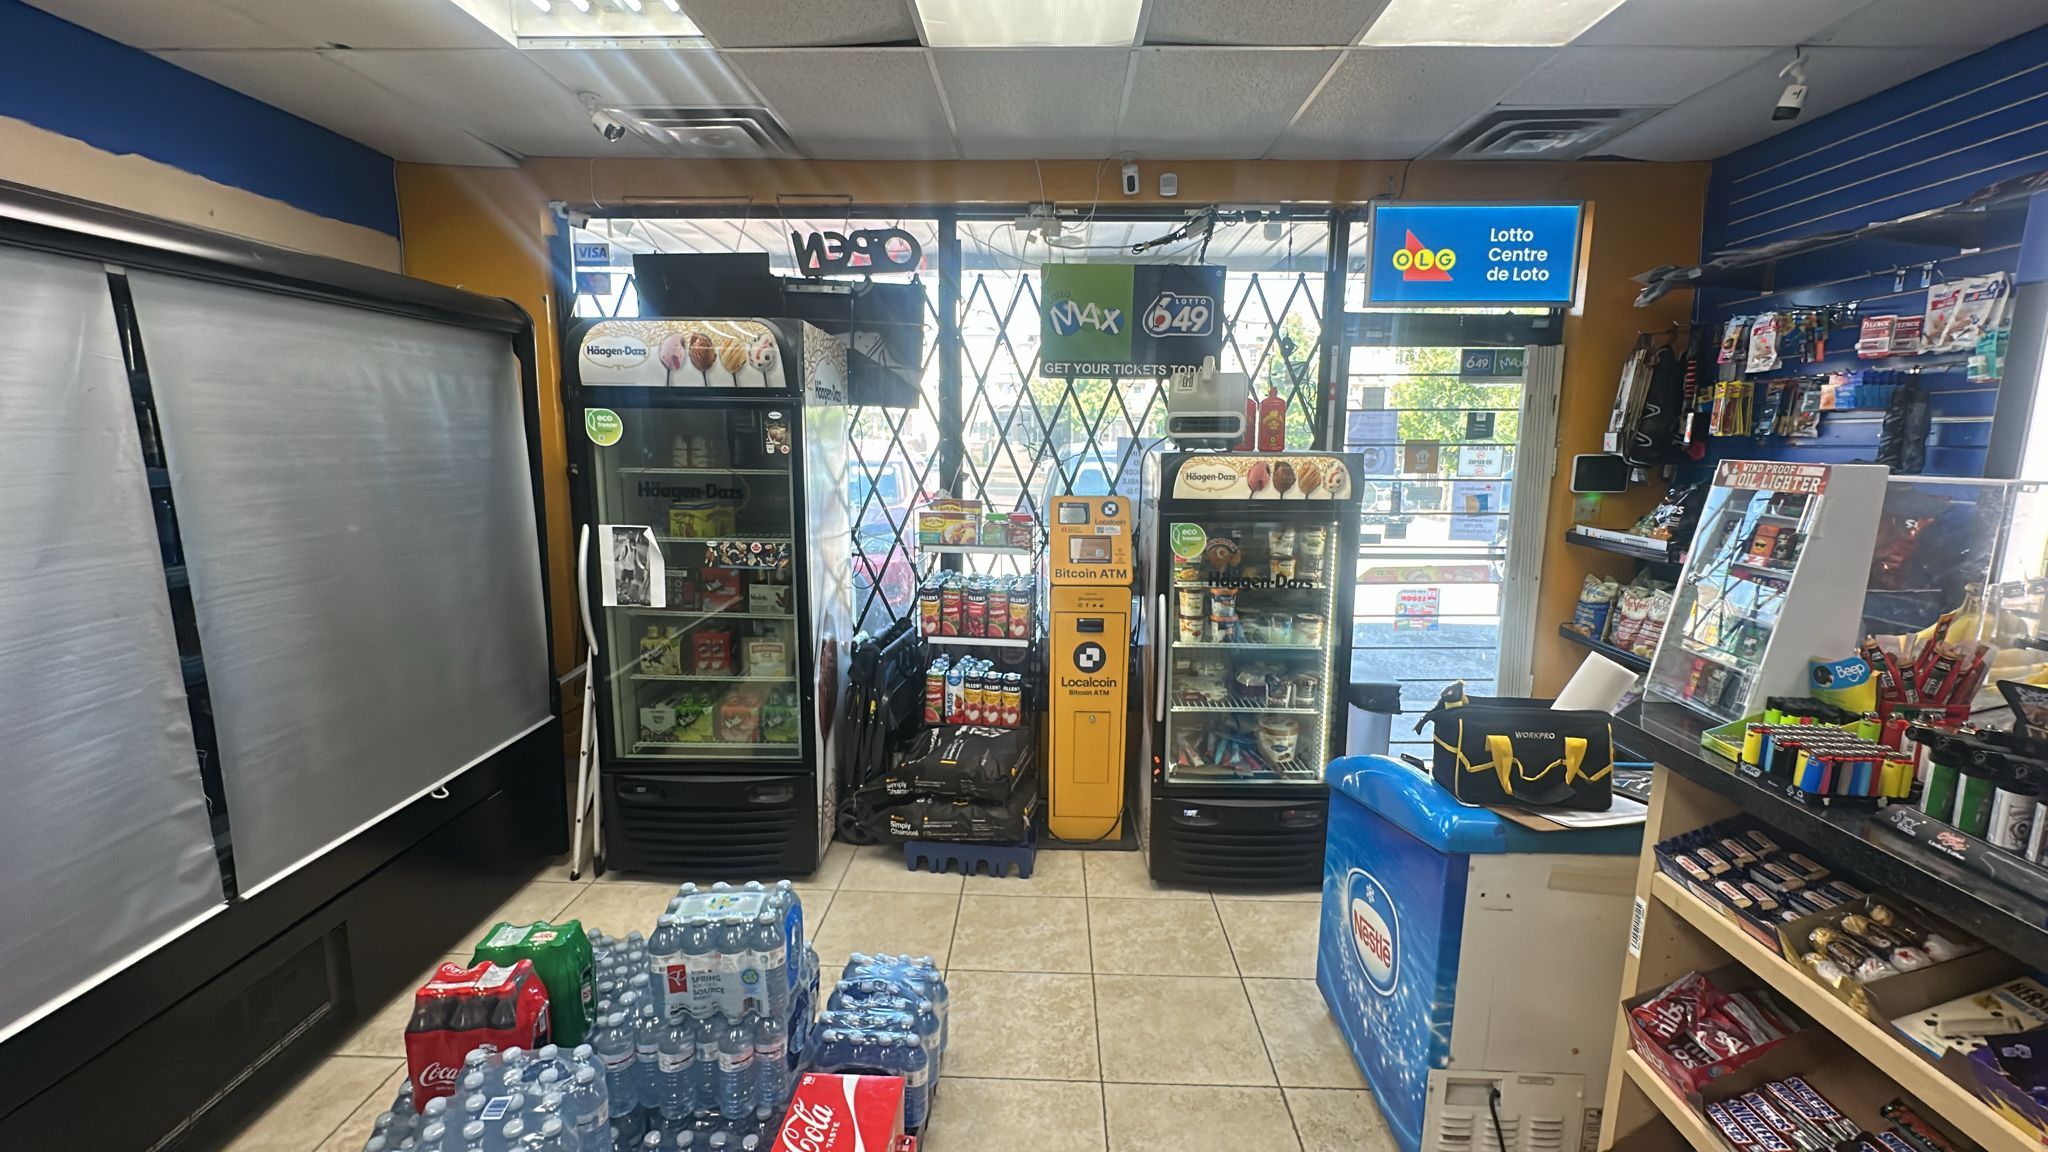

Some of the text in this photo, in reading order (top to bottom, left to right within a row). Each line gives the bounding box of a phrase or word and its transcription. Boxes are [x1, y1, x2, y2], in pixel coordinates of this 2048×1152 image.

[1489, 227, 1534, 242] Lotto
[579, 246, 608, 258] VISA
[1488, 247, 1548, 262] Centre
[1394, 251, 1454, 268] OLG
[1487, 267, 1550, 281] de Loto
[1050, 300, 1121, 336] MAX
[1149, 298, 1209, 333] 649
[587, 344, 647, 358] Häagen-Dazs
[1044, 362, 1071, 374] GET
[1073, 363, 1110, 375] YOUR
[1113, 364, 1167, 376] TICKETS
[1742, 463, 1797, 475] WIND PROOF
[1186, 472, 1236, 484] Häagen-Dazs
[1737, 473, 1822, 493] OIL LIGHTER
[638, 481, 743, 501] Häagen-Dazs
[1055, 568, 1127, 579] Bitcoin ATM
[1208, 571, 1313, 592] Häagen-Dazs
[1836, 663, 1865, 679] Beep
[1061, 677, 1117, 688] Localcoin
[946, 692, 954, 716] OASIS
[1515, 731, 1556, 740] WORKPRO
[890, 820, 911, 831] Simply
[890, 828, 919, 837] Charcoal
[1353, 909, 1391, 969] Nestlé
[691, 974, 722, 984] SPRING
[692, 987, 725, 997] SOURCE
[1656, 1002, 1686, 1039] nibs
[825, 1121, 841, 1149] TASTE
